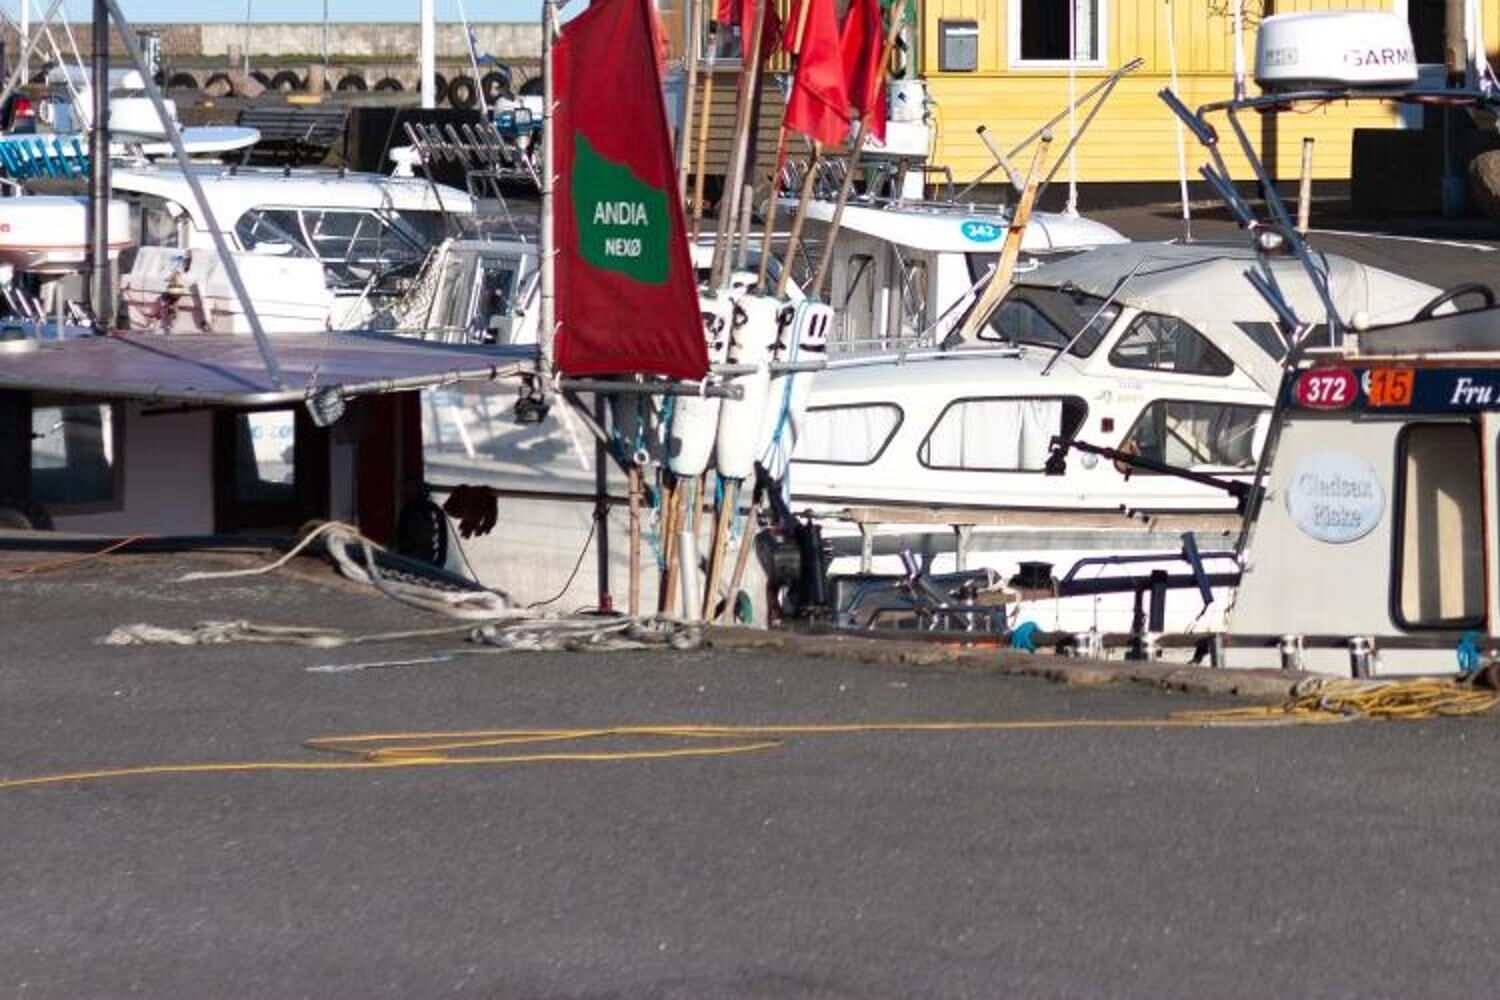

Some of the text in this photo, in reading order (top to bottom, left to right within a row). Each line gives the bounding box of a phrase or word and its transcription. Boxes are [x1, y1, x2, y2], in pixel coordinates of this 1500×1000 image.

[593, 201, 648, 227] ANDIA
[605, 238, 641, 257] NEXØ
[1307, 377, 1347, 402] 372
[1376, 371, 1408, 403] 15
[1449, 376, 1492, 404] Fru
